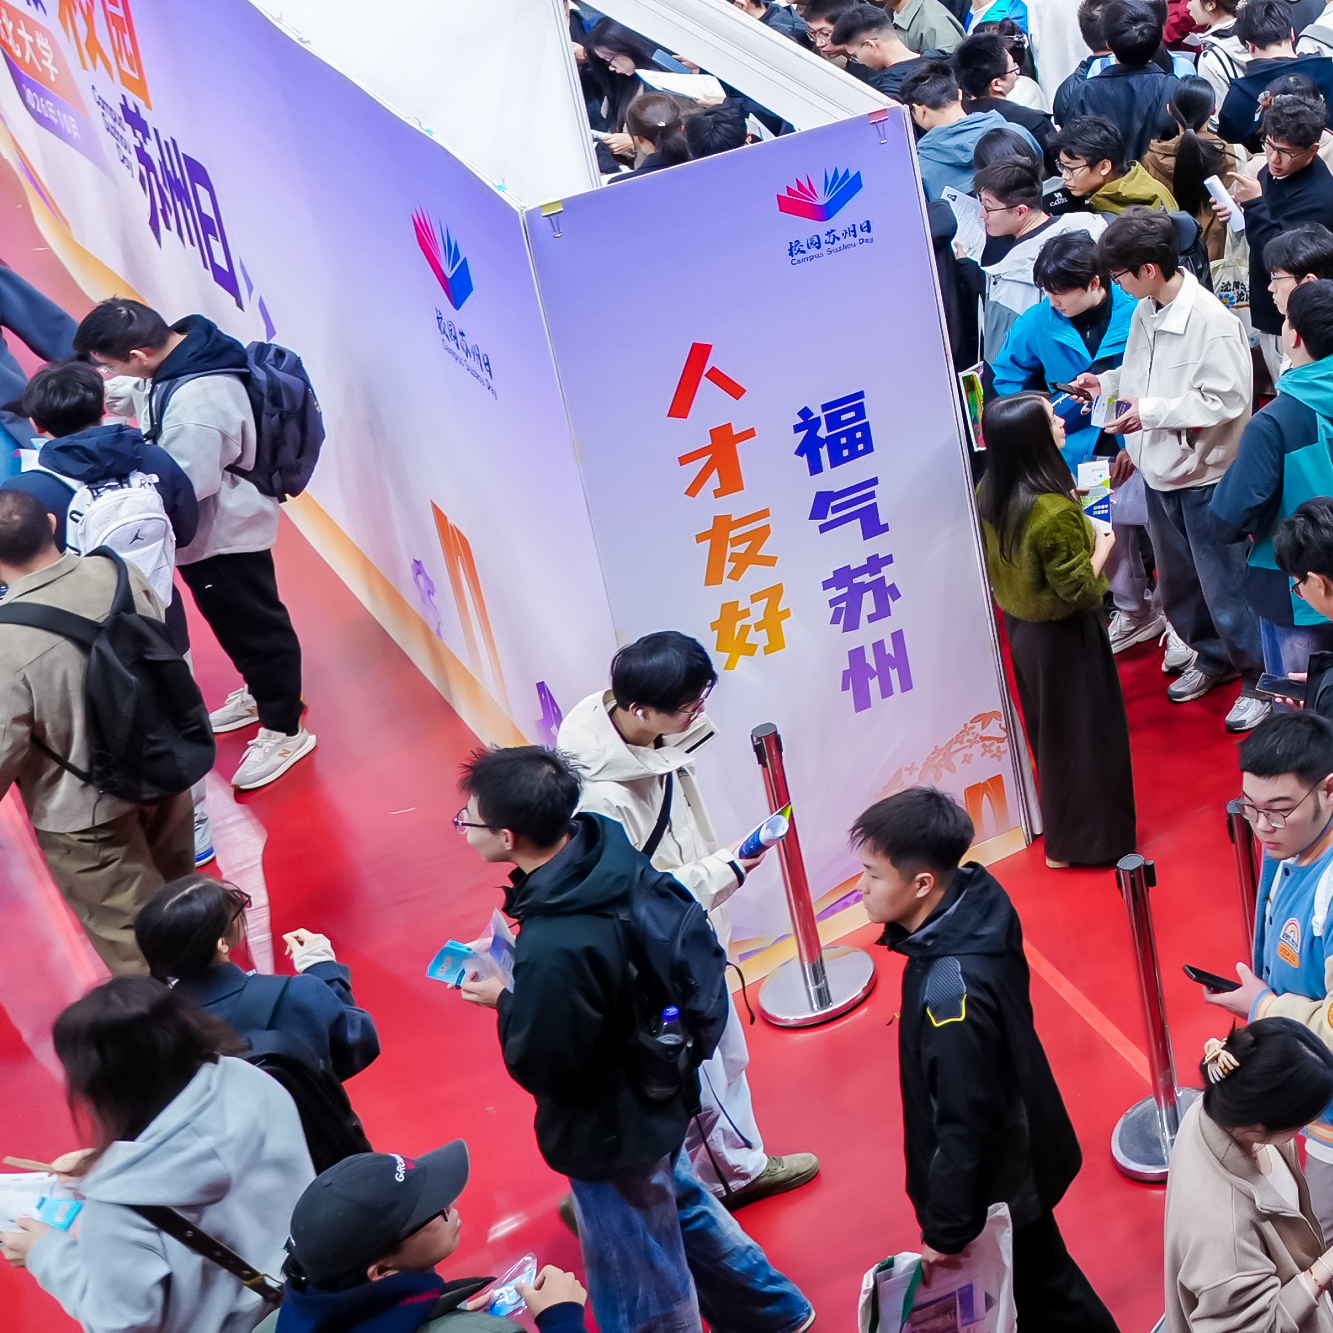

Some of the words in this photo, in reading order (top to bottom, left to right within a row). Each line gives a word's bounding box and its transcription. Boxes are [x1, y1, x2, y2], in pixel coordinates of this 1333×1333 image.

[121, 94, 244, 313] 苏州日
[788, 219, 872, 258] 校园苏州日
[1050, 197, 1068, 207] CAMEL
[790, 251, 824, 266] Campus
[826, 240, 857, 256] Suzhou
[859, 235, 874, 249] Day
[435, 306, 493, 380] 校园苏州日
[666, 341, 792, 671] 人才友好
[792, 389, 914, 714] 福气苏州
